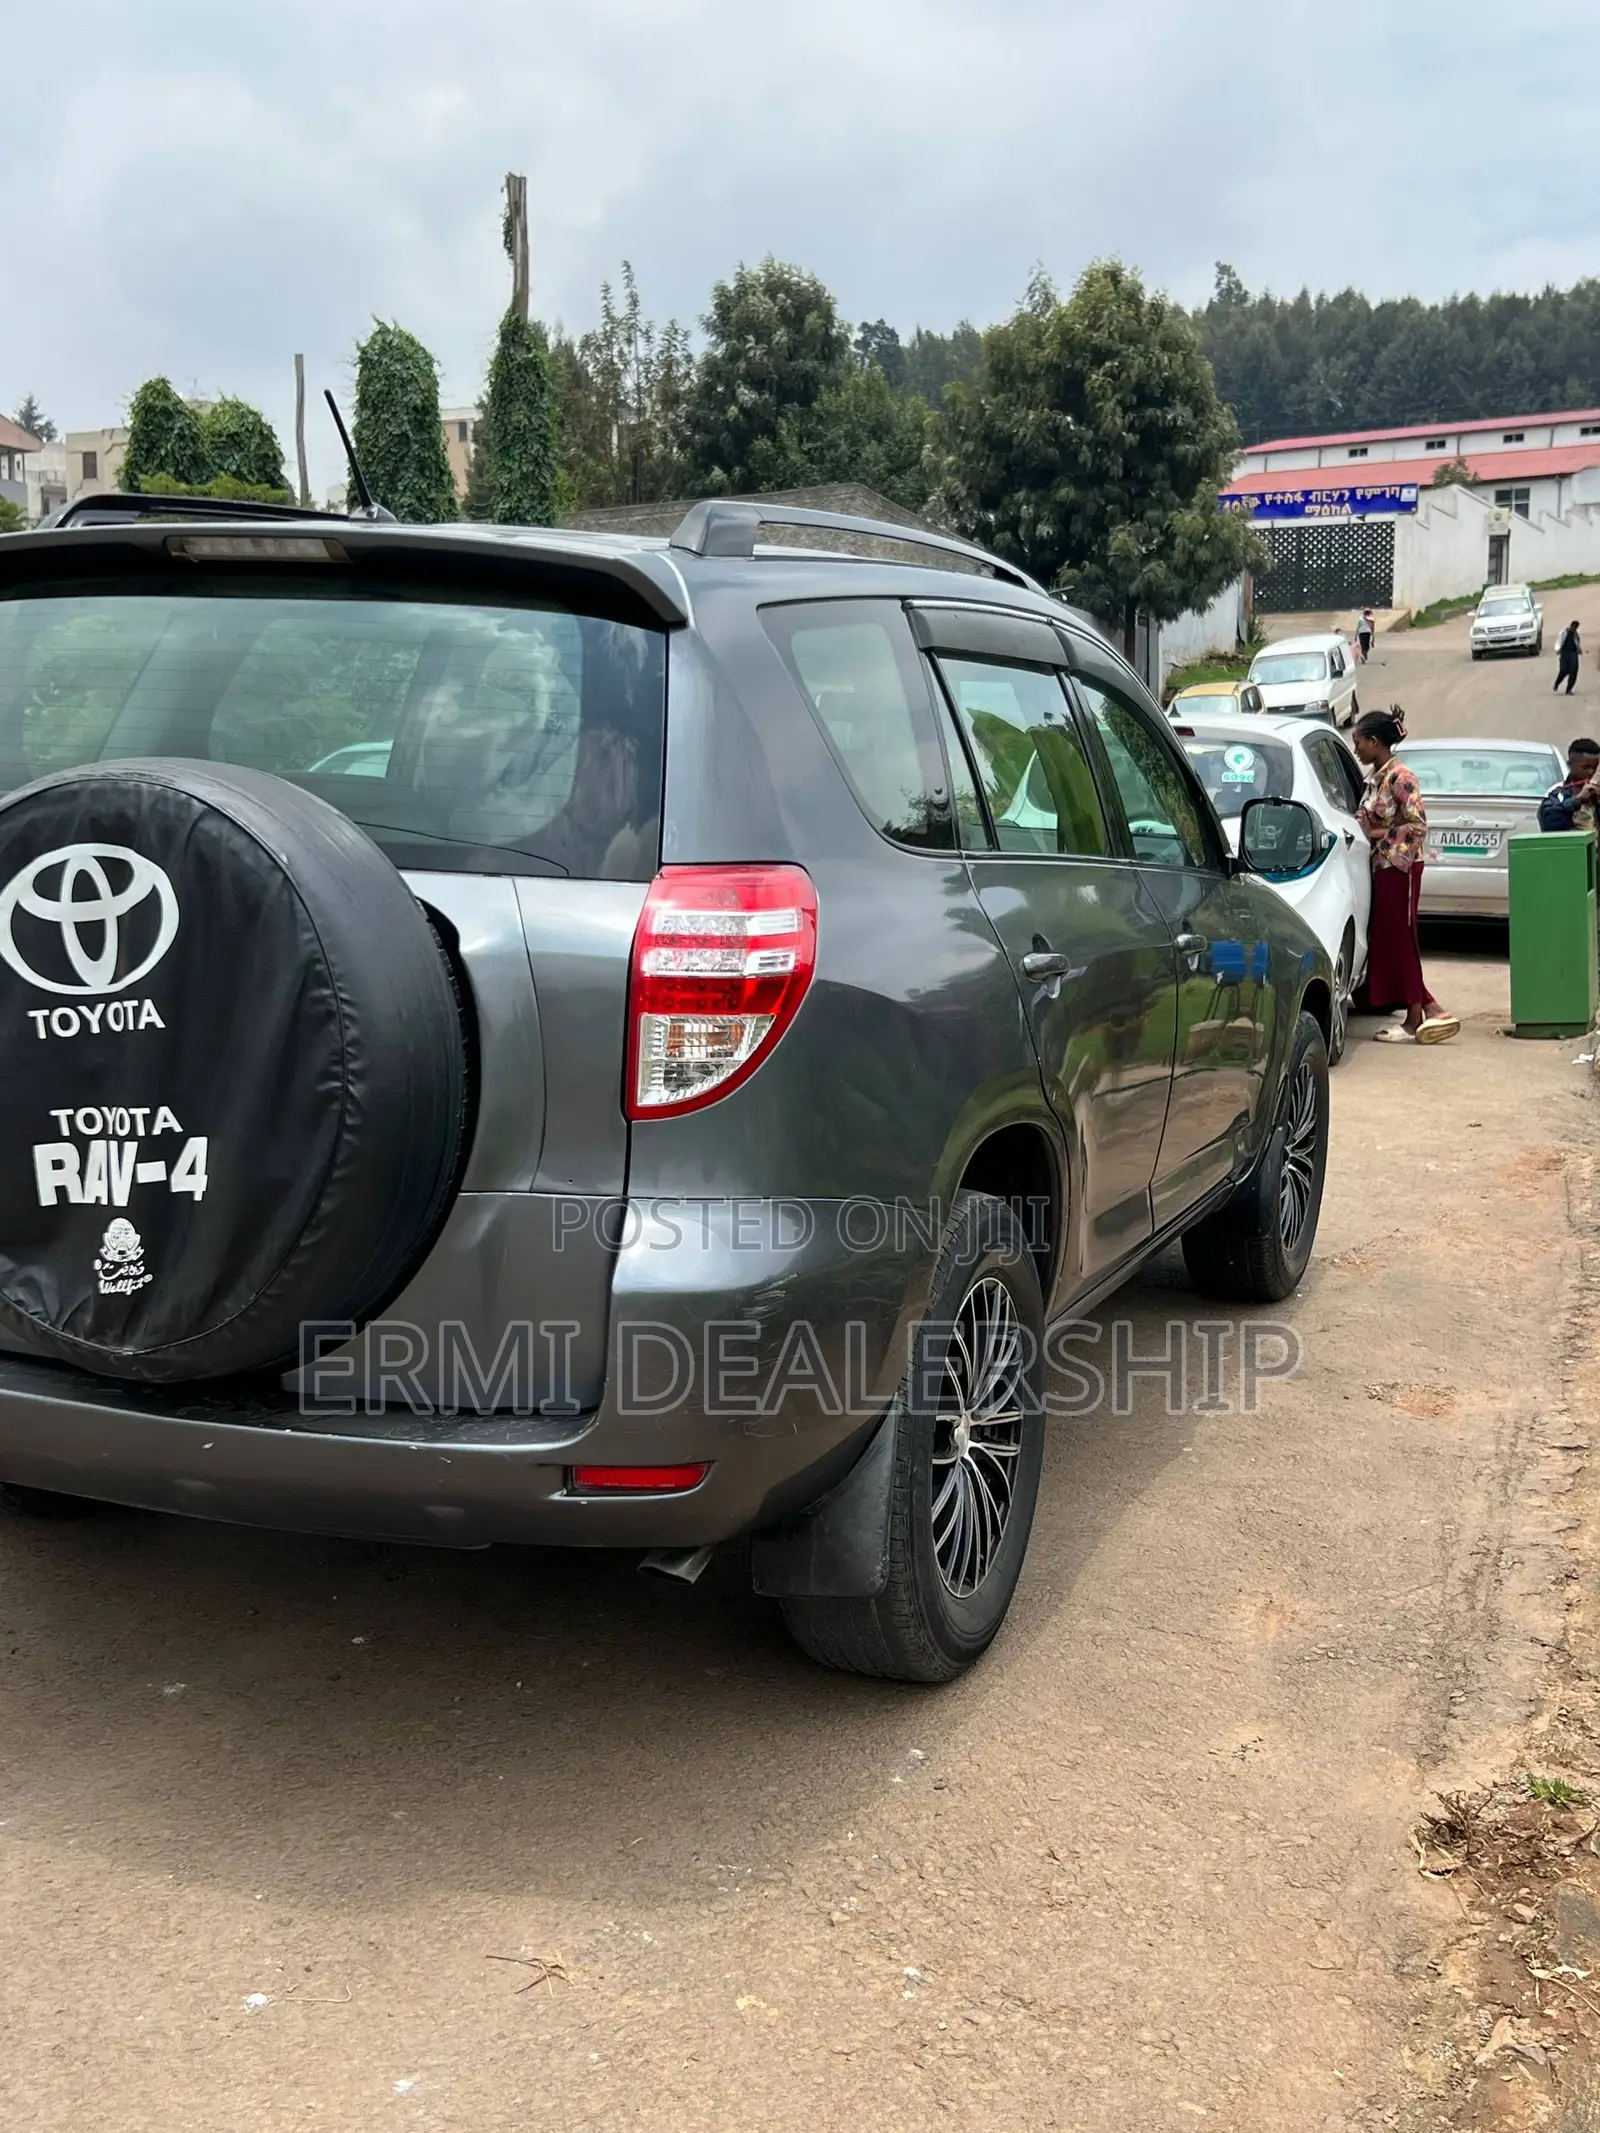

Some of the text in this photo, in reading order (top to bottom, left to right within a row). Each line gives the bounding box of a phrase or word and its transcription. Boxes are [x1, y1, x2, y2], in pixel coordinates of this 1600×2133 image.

[1440, 832, 1498, 846] AAL6255
[27, 999, 166, 1040] TOYOTA
[49, 1106, 184, 1136] TOYOTA
[33, 1136, 208, 1207] RAV-4
